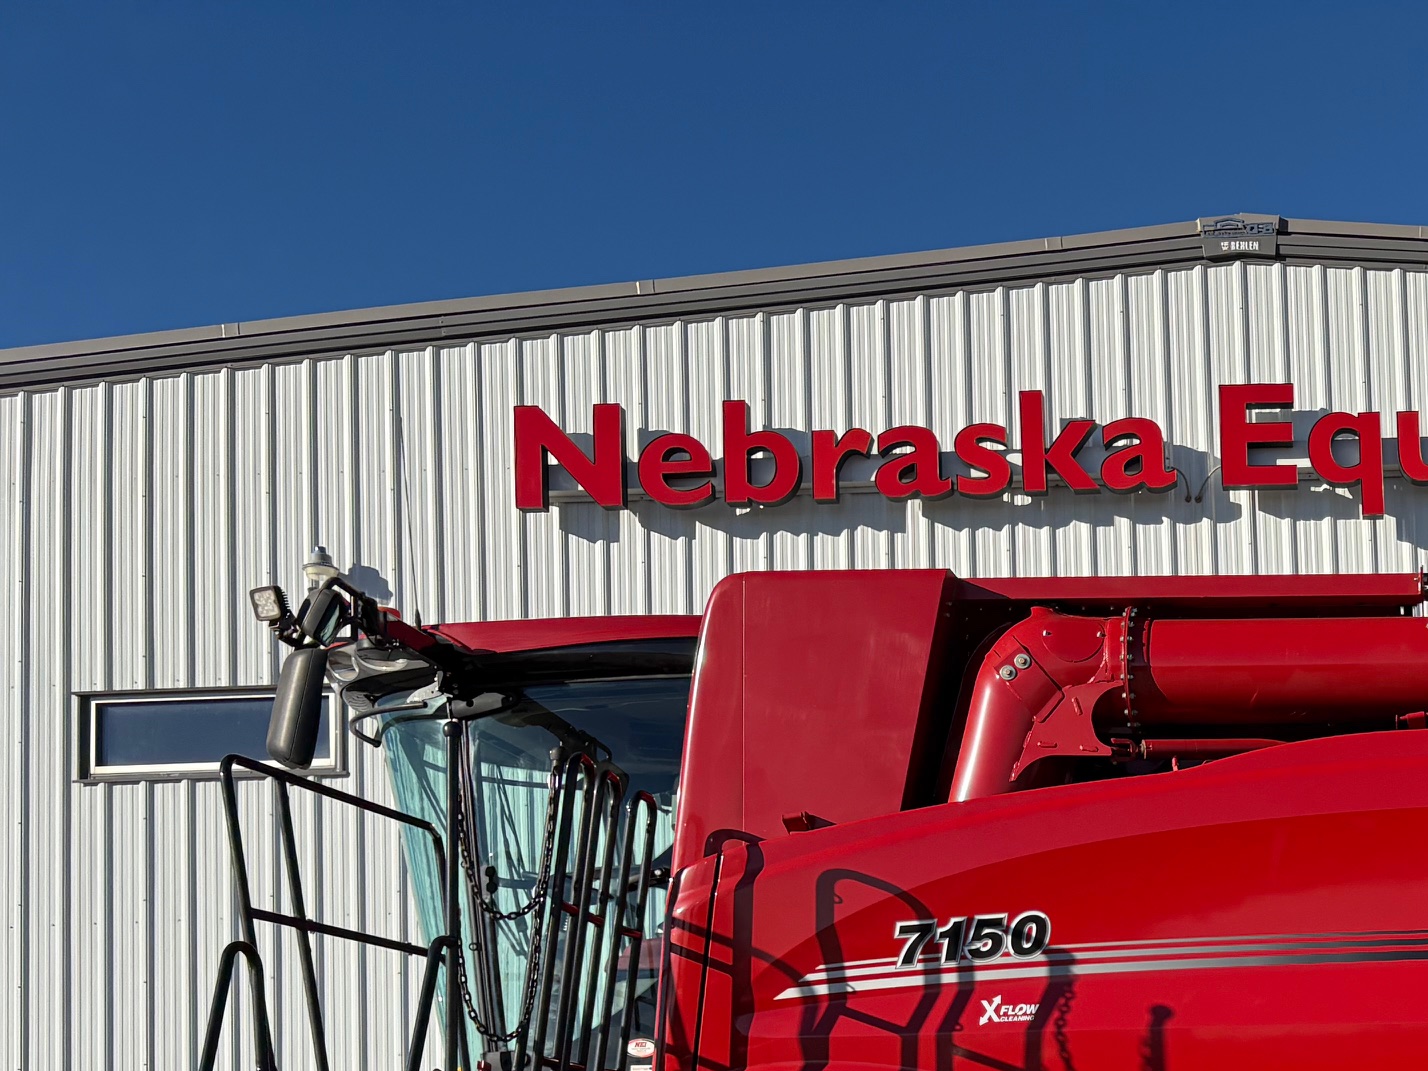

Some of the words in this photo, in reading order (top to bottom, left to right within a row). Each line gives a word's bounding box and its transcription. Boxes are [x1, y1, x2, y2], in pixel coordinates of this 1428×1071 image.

[514, 390, 1177, 512] Nebraska
[894, 910, 1051, 969] 7150
[1000, 1004, 1039, 1015] FLOW
